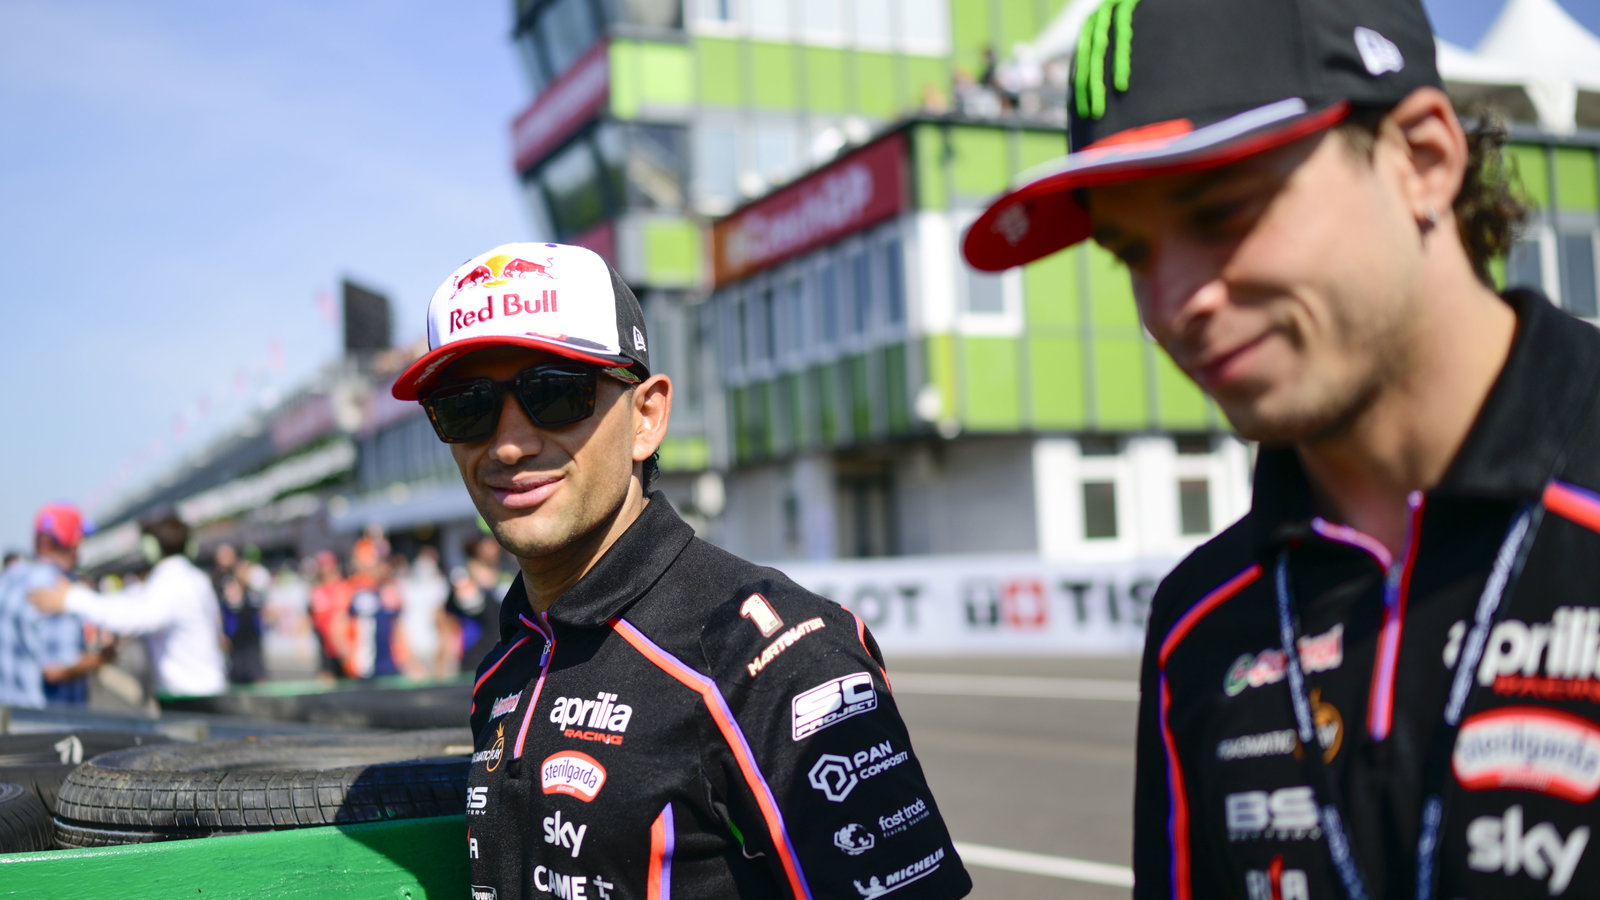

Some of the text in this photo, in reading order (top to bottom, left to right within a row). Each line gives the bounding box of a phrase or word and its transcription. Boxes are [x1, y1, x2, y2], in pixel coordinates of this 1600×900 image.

[450, 290, 558, 334] Red Bull
[739, 592, 785, 639] 1
[550, 691, 633, 732] aprilia
[795, 674, 876, 728] SC
[795, 699, 875, 737] PROJECT
[563, 728, 624, 746] RACING
[853, 740, 893, 768] PAN
[545, 759, 598, 789] sterilgarda
[860, 751, 909, 780] COMPOSITI
[878, 809, 906, 831] fast
[1225, 785, 1320, 831] BS
[543, 810, 588, 858] sky
[1466, 803, 1591, 896] sky
[533, 864, 588, 900] CAME
[885, 847, 945, 887] MICHELIN
